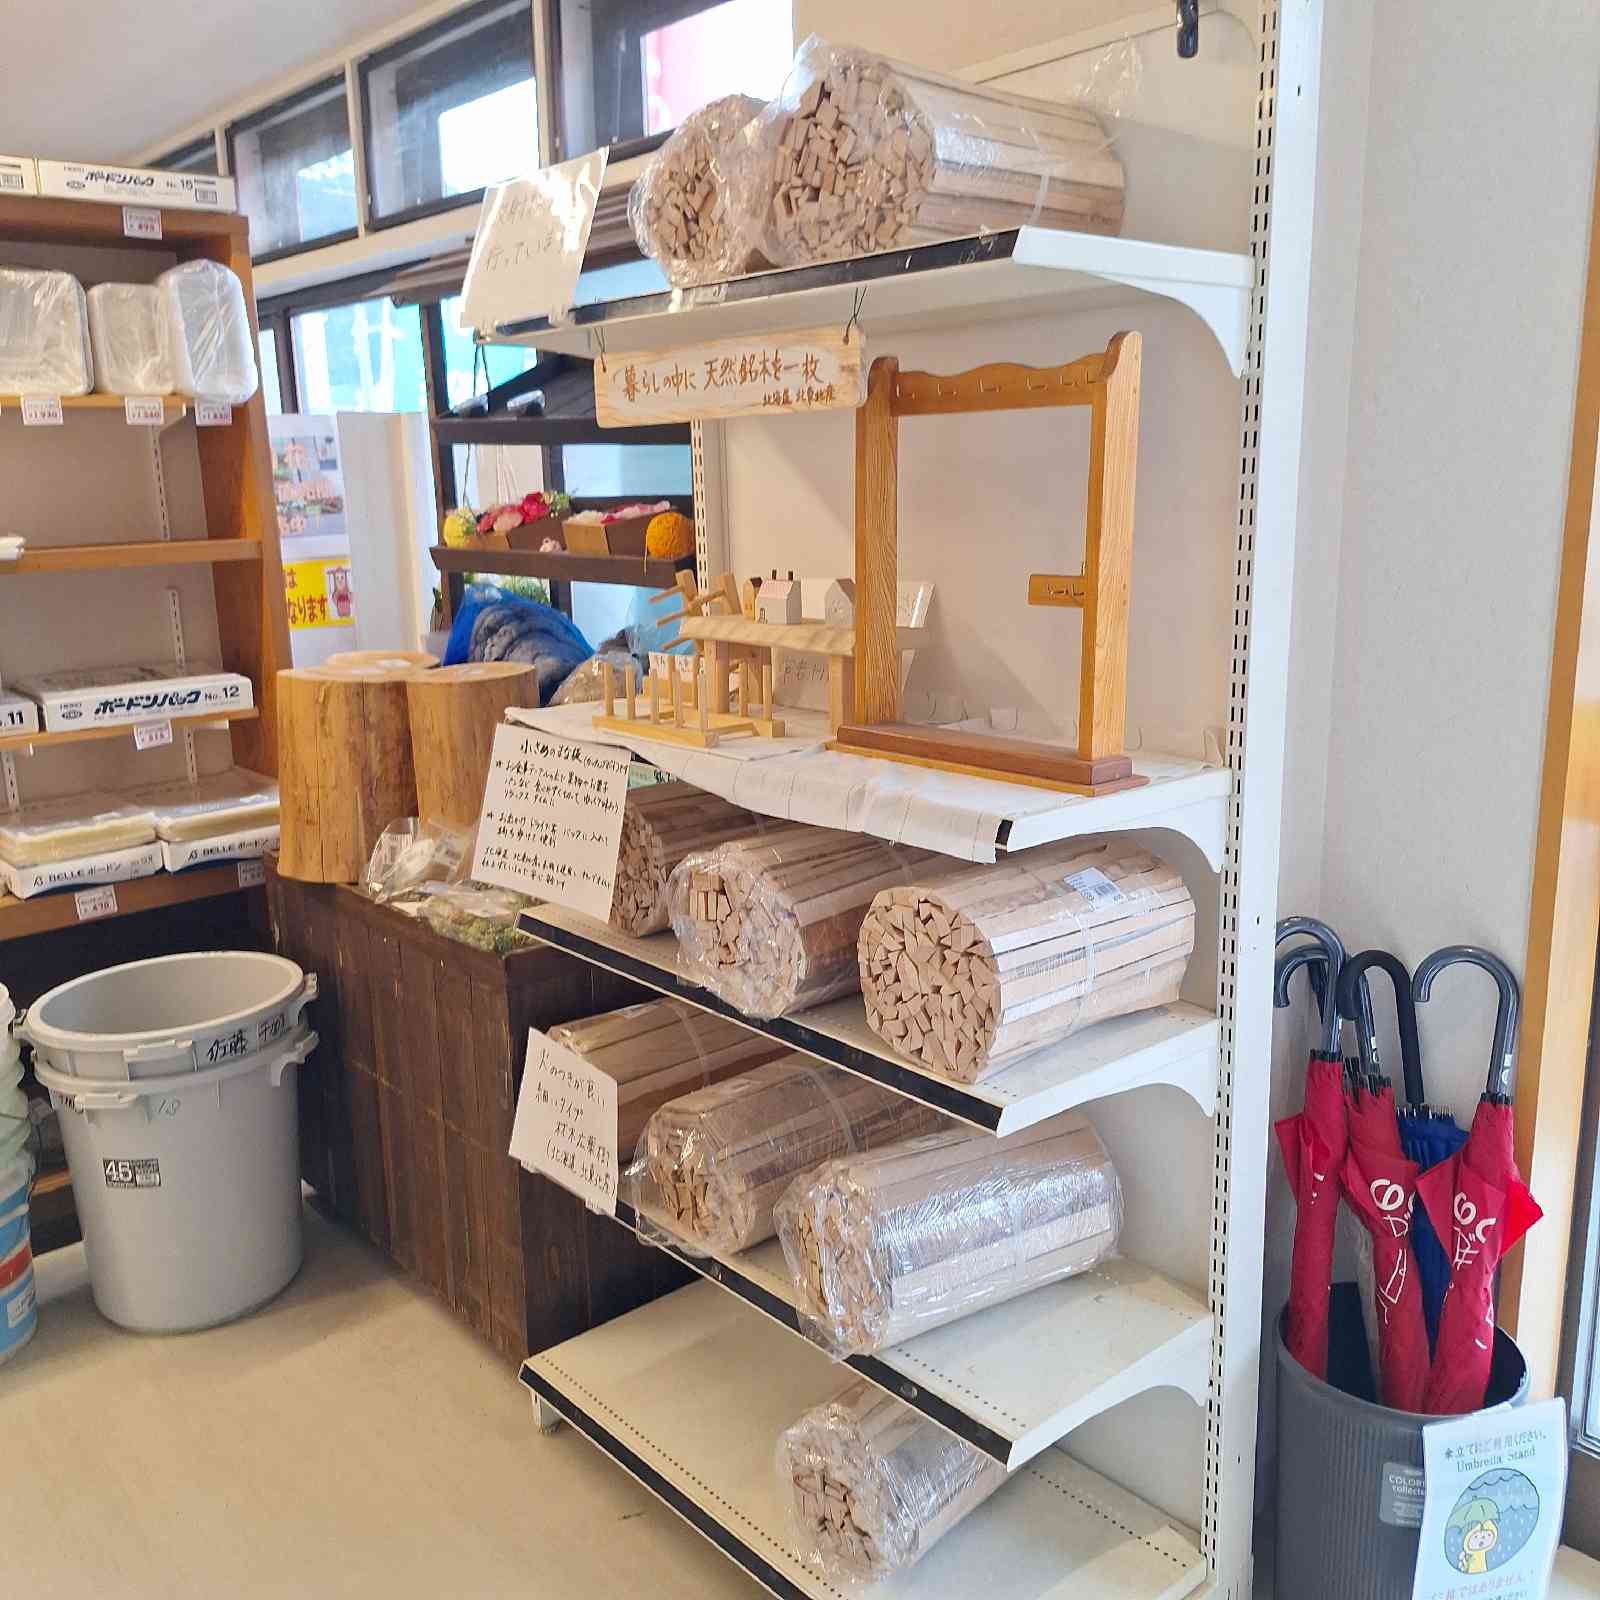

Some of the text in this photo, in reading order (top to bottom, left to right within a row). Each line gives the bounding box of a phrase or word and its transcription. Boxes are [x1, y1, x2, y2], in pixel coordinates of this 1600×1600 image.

[287, 593, 328, 624] なります
[94, 690, 202, 716] ボードンパック
[1456, 1455, 1503, 1473] Umbrella
